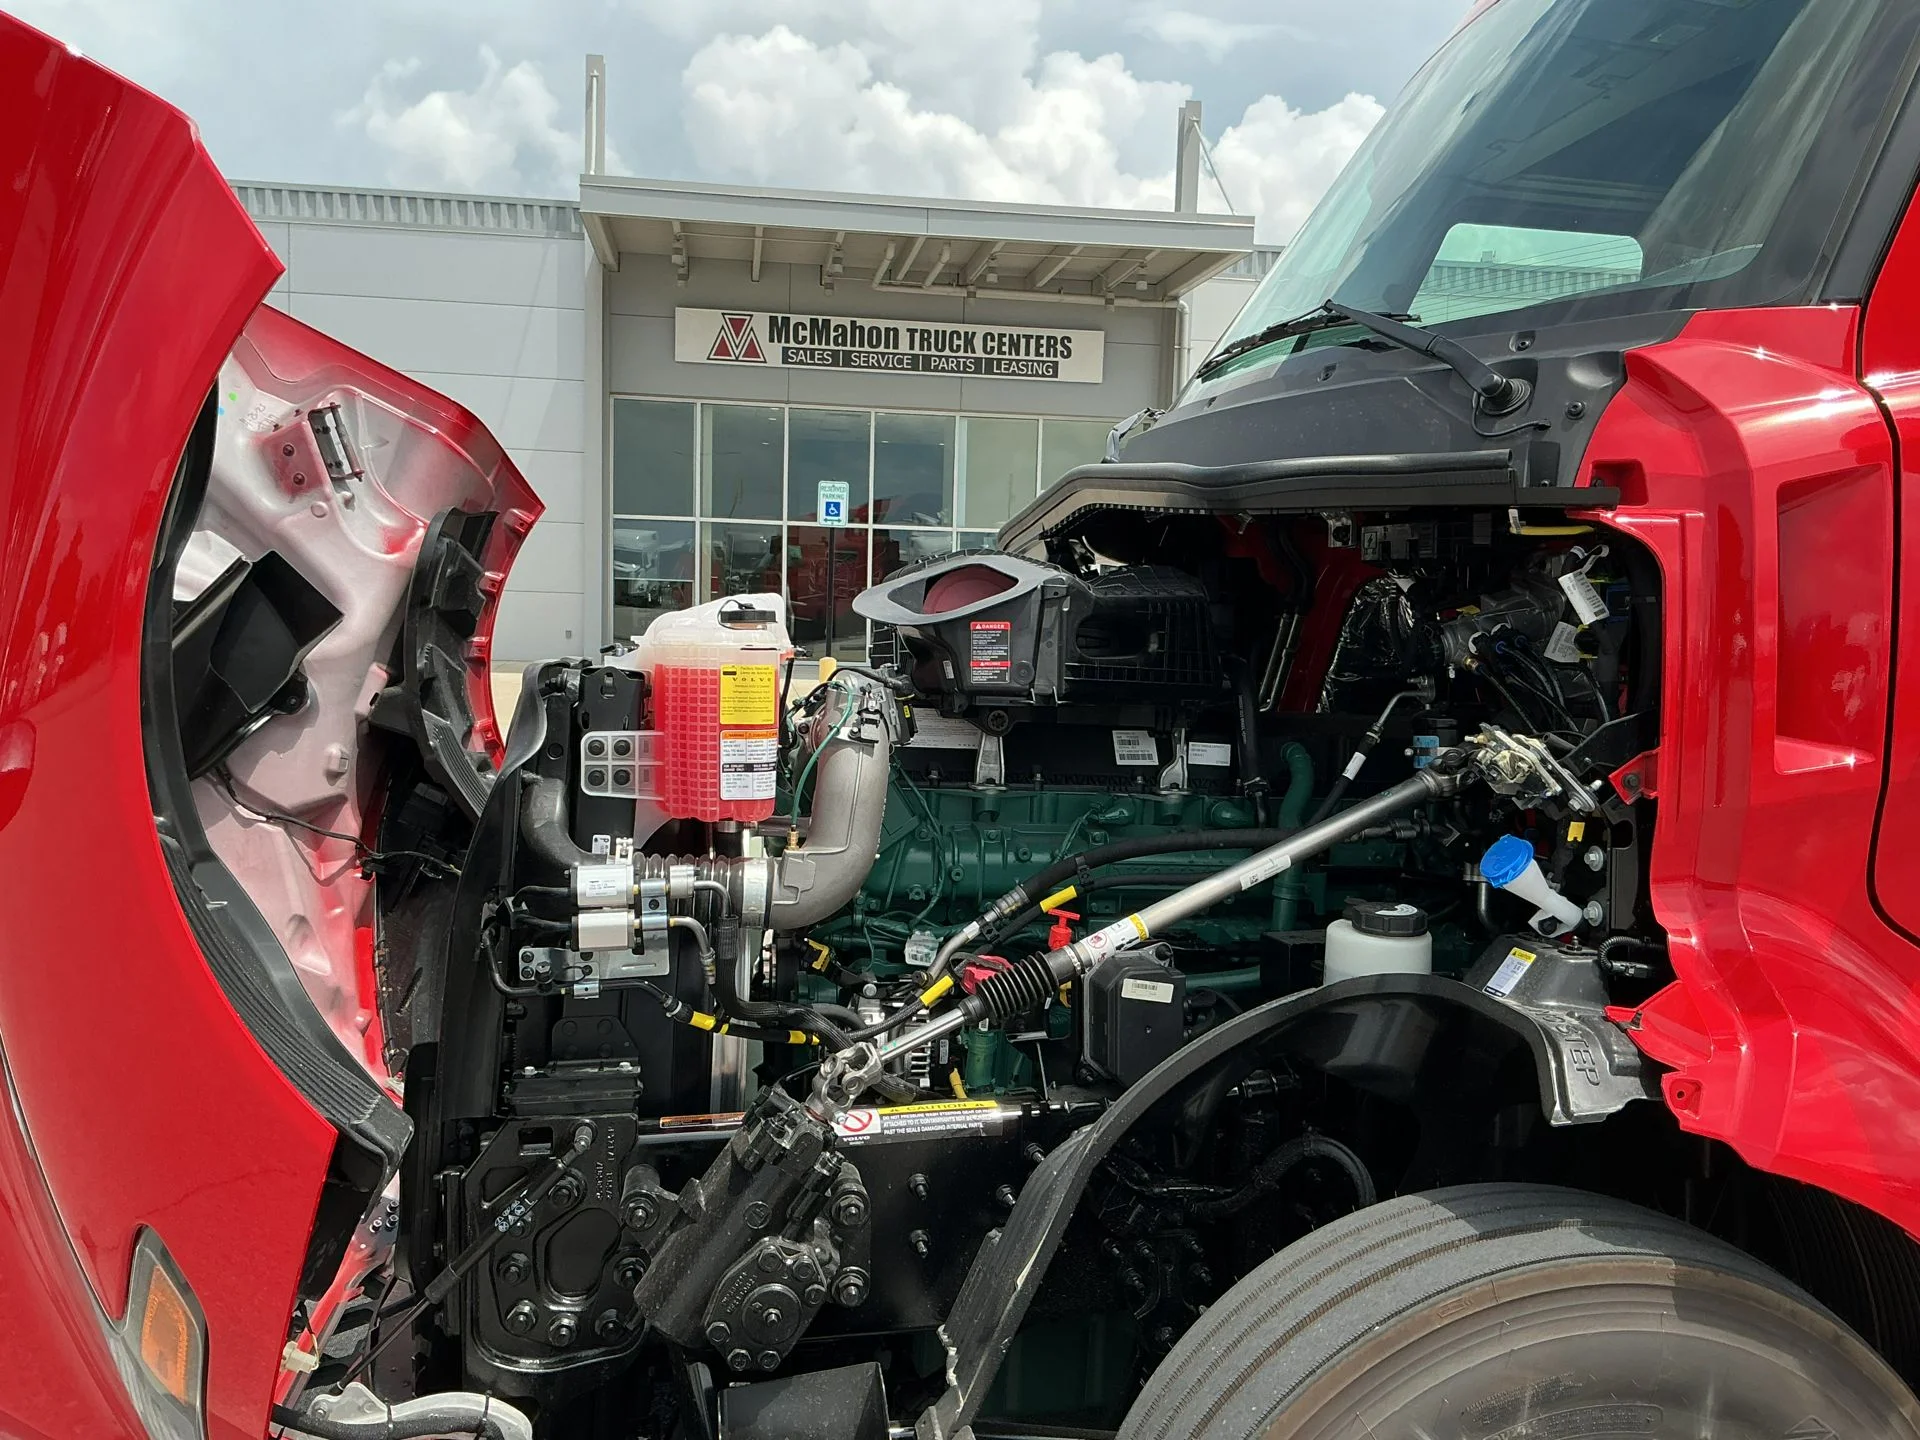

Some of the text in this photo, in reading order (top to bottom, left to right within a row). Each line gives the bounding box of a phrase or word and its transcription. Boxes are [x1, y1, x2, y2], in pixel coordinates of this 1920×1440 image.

[768, 315, 1073, 359] McMahon TRUCK CENTERS
[787, 349, 1054, 376] SALES SERVICE PARTS LEASING
[906, 1103, 967, 1111] CAUTION
